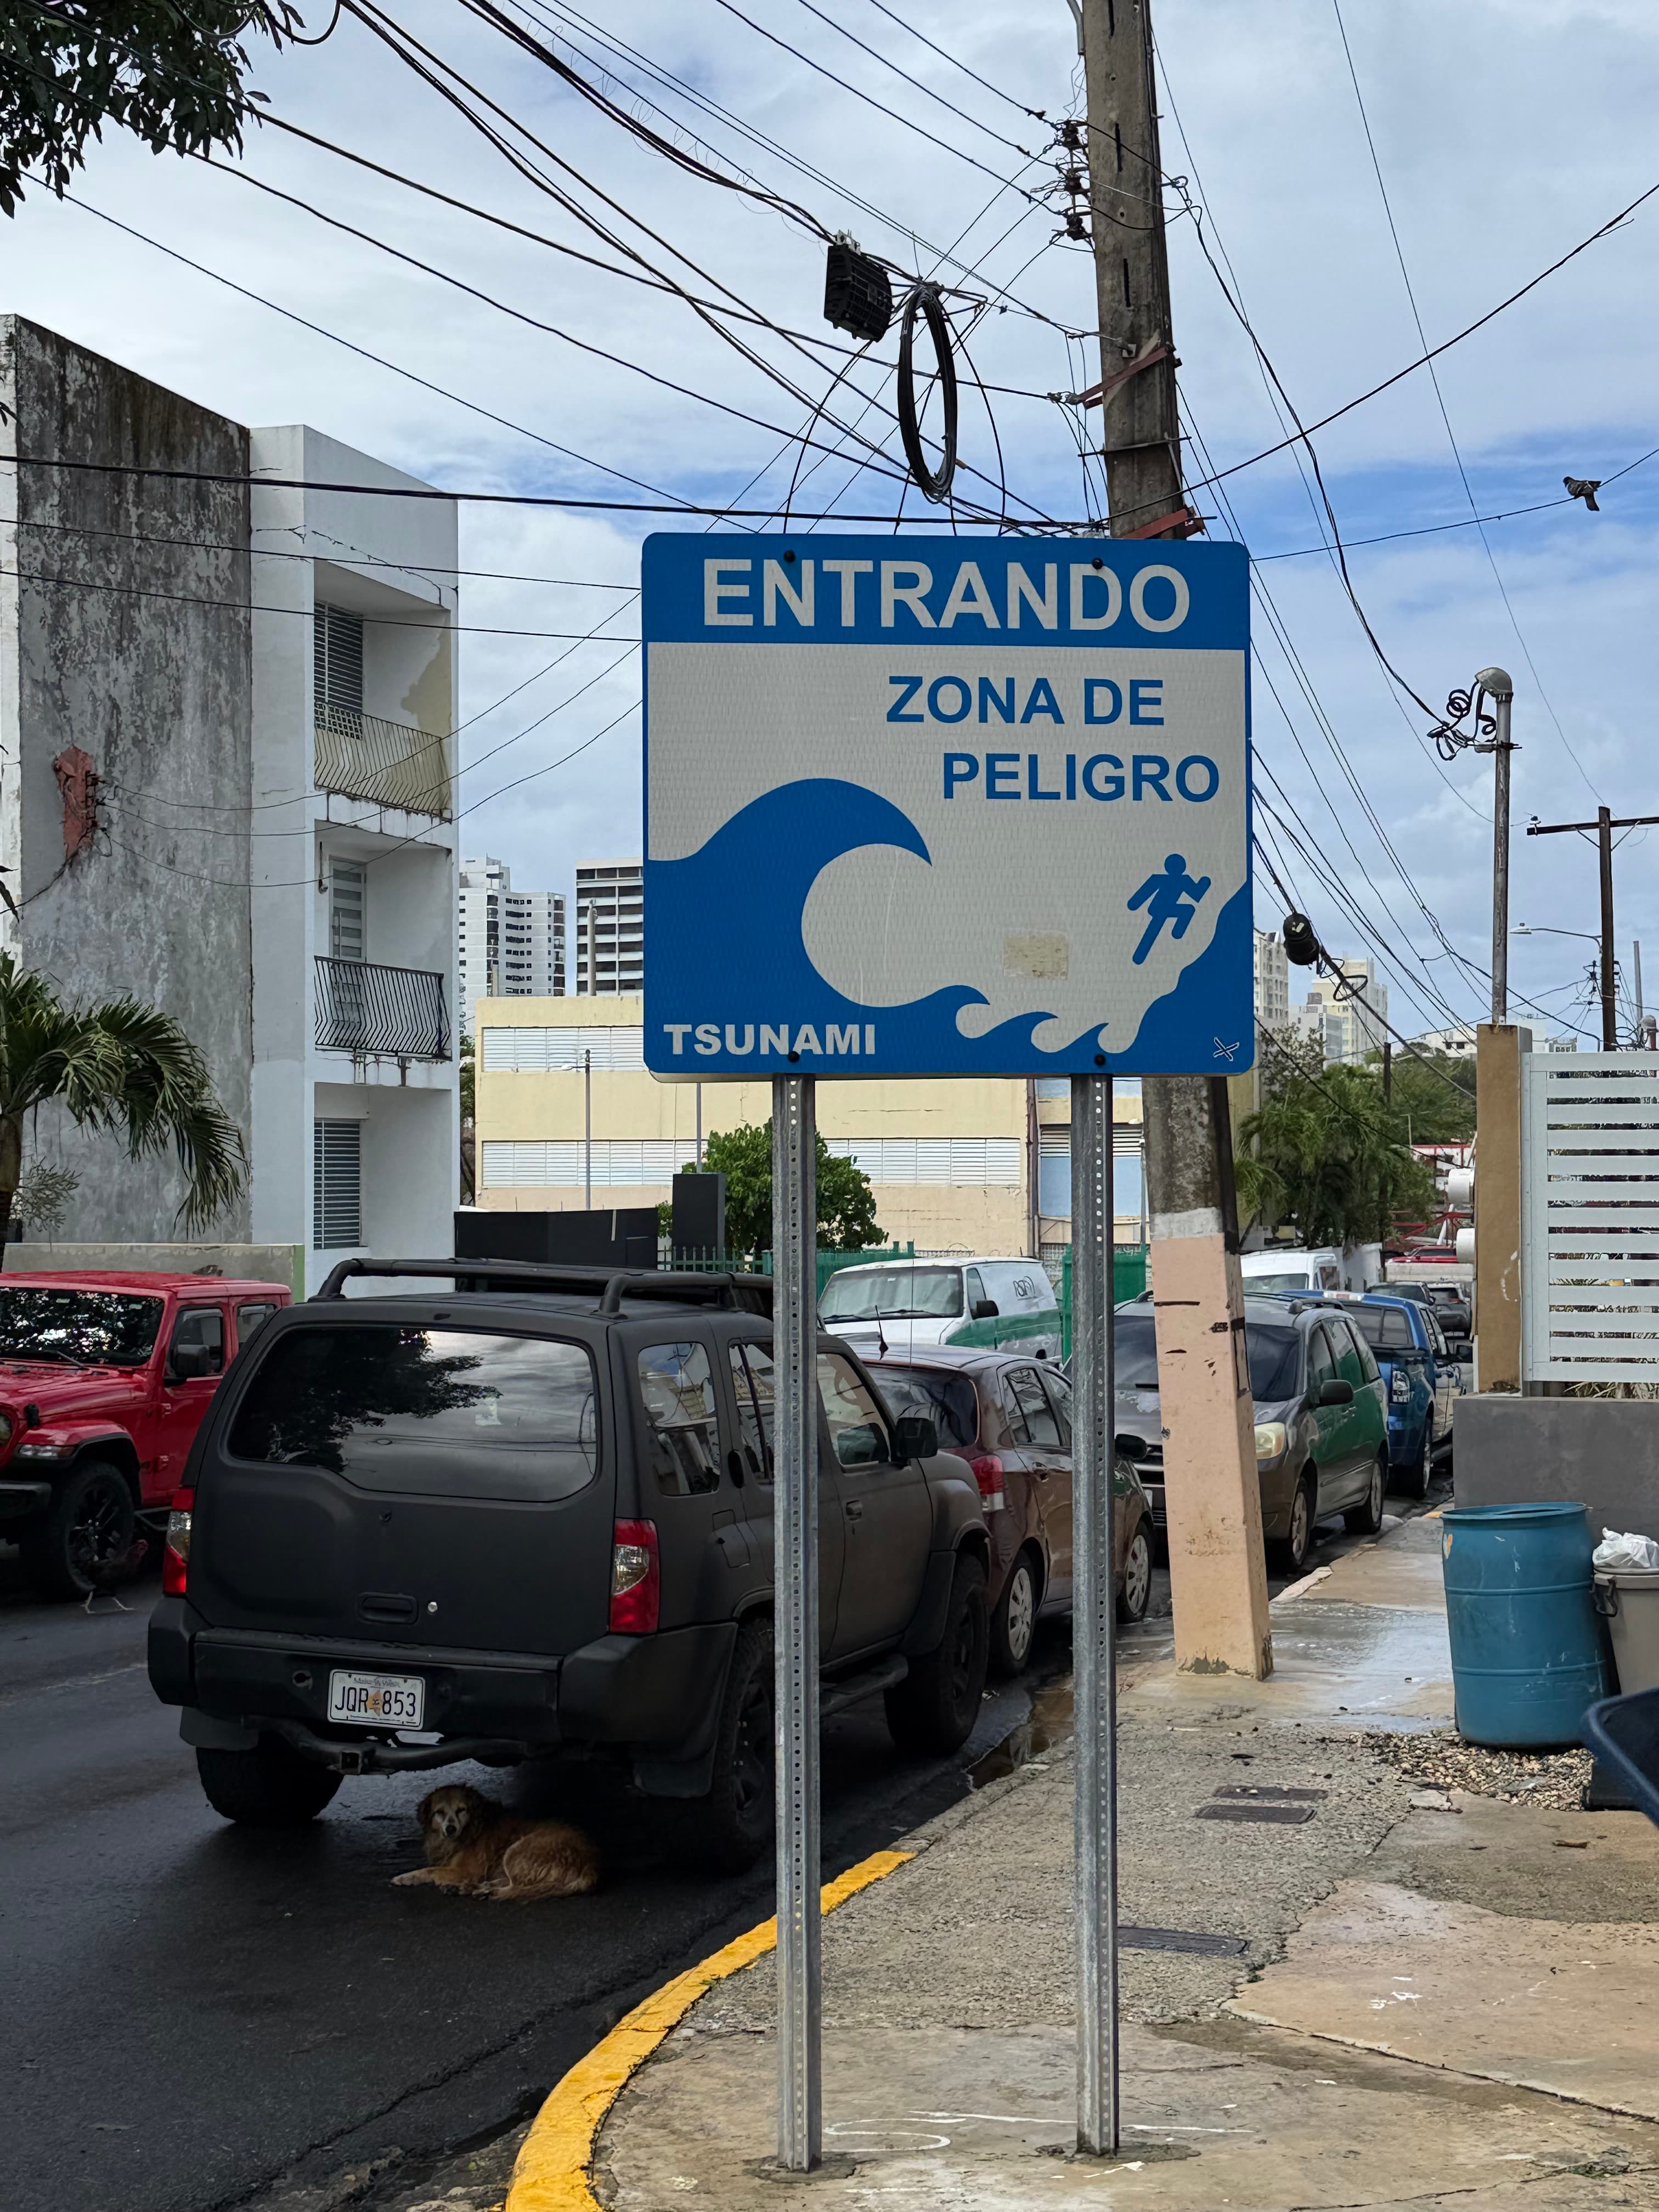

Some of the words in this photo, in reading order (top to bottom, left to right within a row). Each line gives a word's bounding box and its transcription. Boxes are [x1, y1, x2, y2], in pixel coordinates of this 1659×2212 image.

[705, 559, 1189, 632] ENTRANDO
[887, 676, 1064, 724] ZONA
[1085, 679, 1164, 725] DE
[944, 753, 1218, 802] PELIGRO
[664, 1024, 874, 1054] TSUNAMI
[335, 1686, 369, 1713] JQR
[382, 1690, 416, 1717] 853
